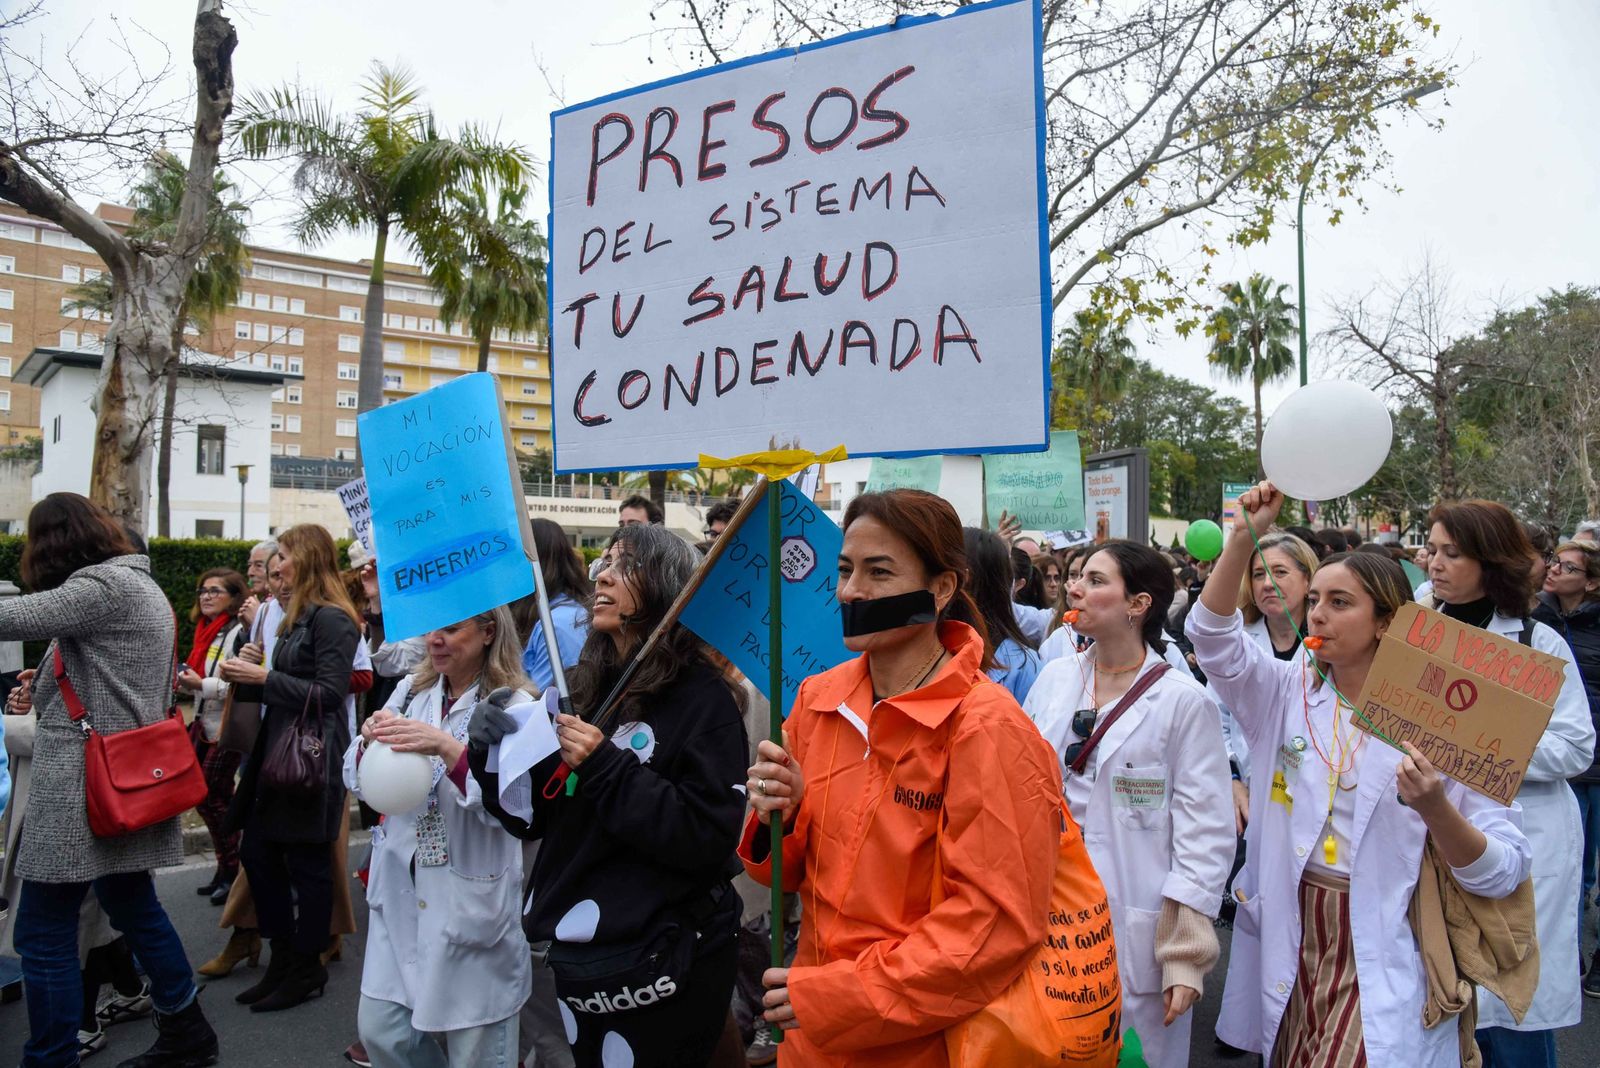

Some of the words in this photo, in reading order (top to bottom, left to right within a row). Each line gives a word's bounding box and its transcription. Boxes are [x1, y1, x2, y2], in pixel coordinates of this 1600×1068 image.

[587, 65, 915, 207] PRESOS
[579, 221, 672, 275] DEL
[561, 292, 645, 349] TU
[683, 241, 898, 326] SALUD
[572, 305, 981, 427] CONDENADA
[402, 404, 432, 429] MI
[426, 477, 446, 491] ES
[395, 509, 437, 537] PARA
[460, 486, 492, 507] MIS
[549, 504, 558, 512] DE
[561, 505, 617, 514] DOCUMENTACIÓN
[394, 536, 508, 592] ENFERMOS
[793, 544, 810, 562] STOP
[724, 579, 750, 608] LA
[1406, 609, 1446, 652] LA
[1453, 628, 1561, 703] VOCACIÓN
[1370, 678, 1457, 734] JUSTIFICA
[1475, 731, 1501, 757] LA
[1115, 786, 1132, 794] ESTOY
[1077, 907, 1093, 924] se
[1075, 918, 1112, 950] amor
[1041, 960, 1051, 977] y
[1053, 960, 1066, 976] si
[1066, 959, 1078, 978] lo
[1082, 944, 1116, 977] necesit
[1045, 984, 1097, 1005] aumenta
[1098, 981, 1110, 1001] la
